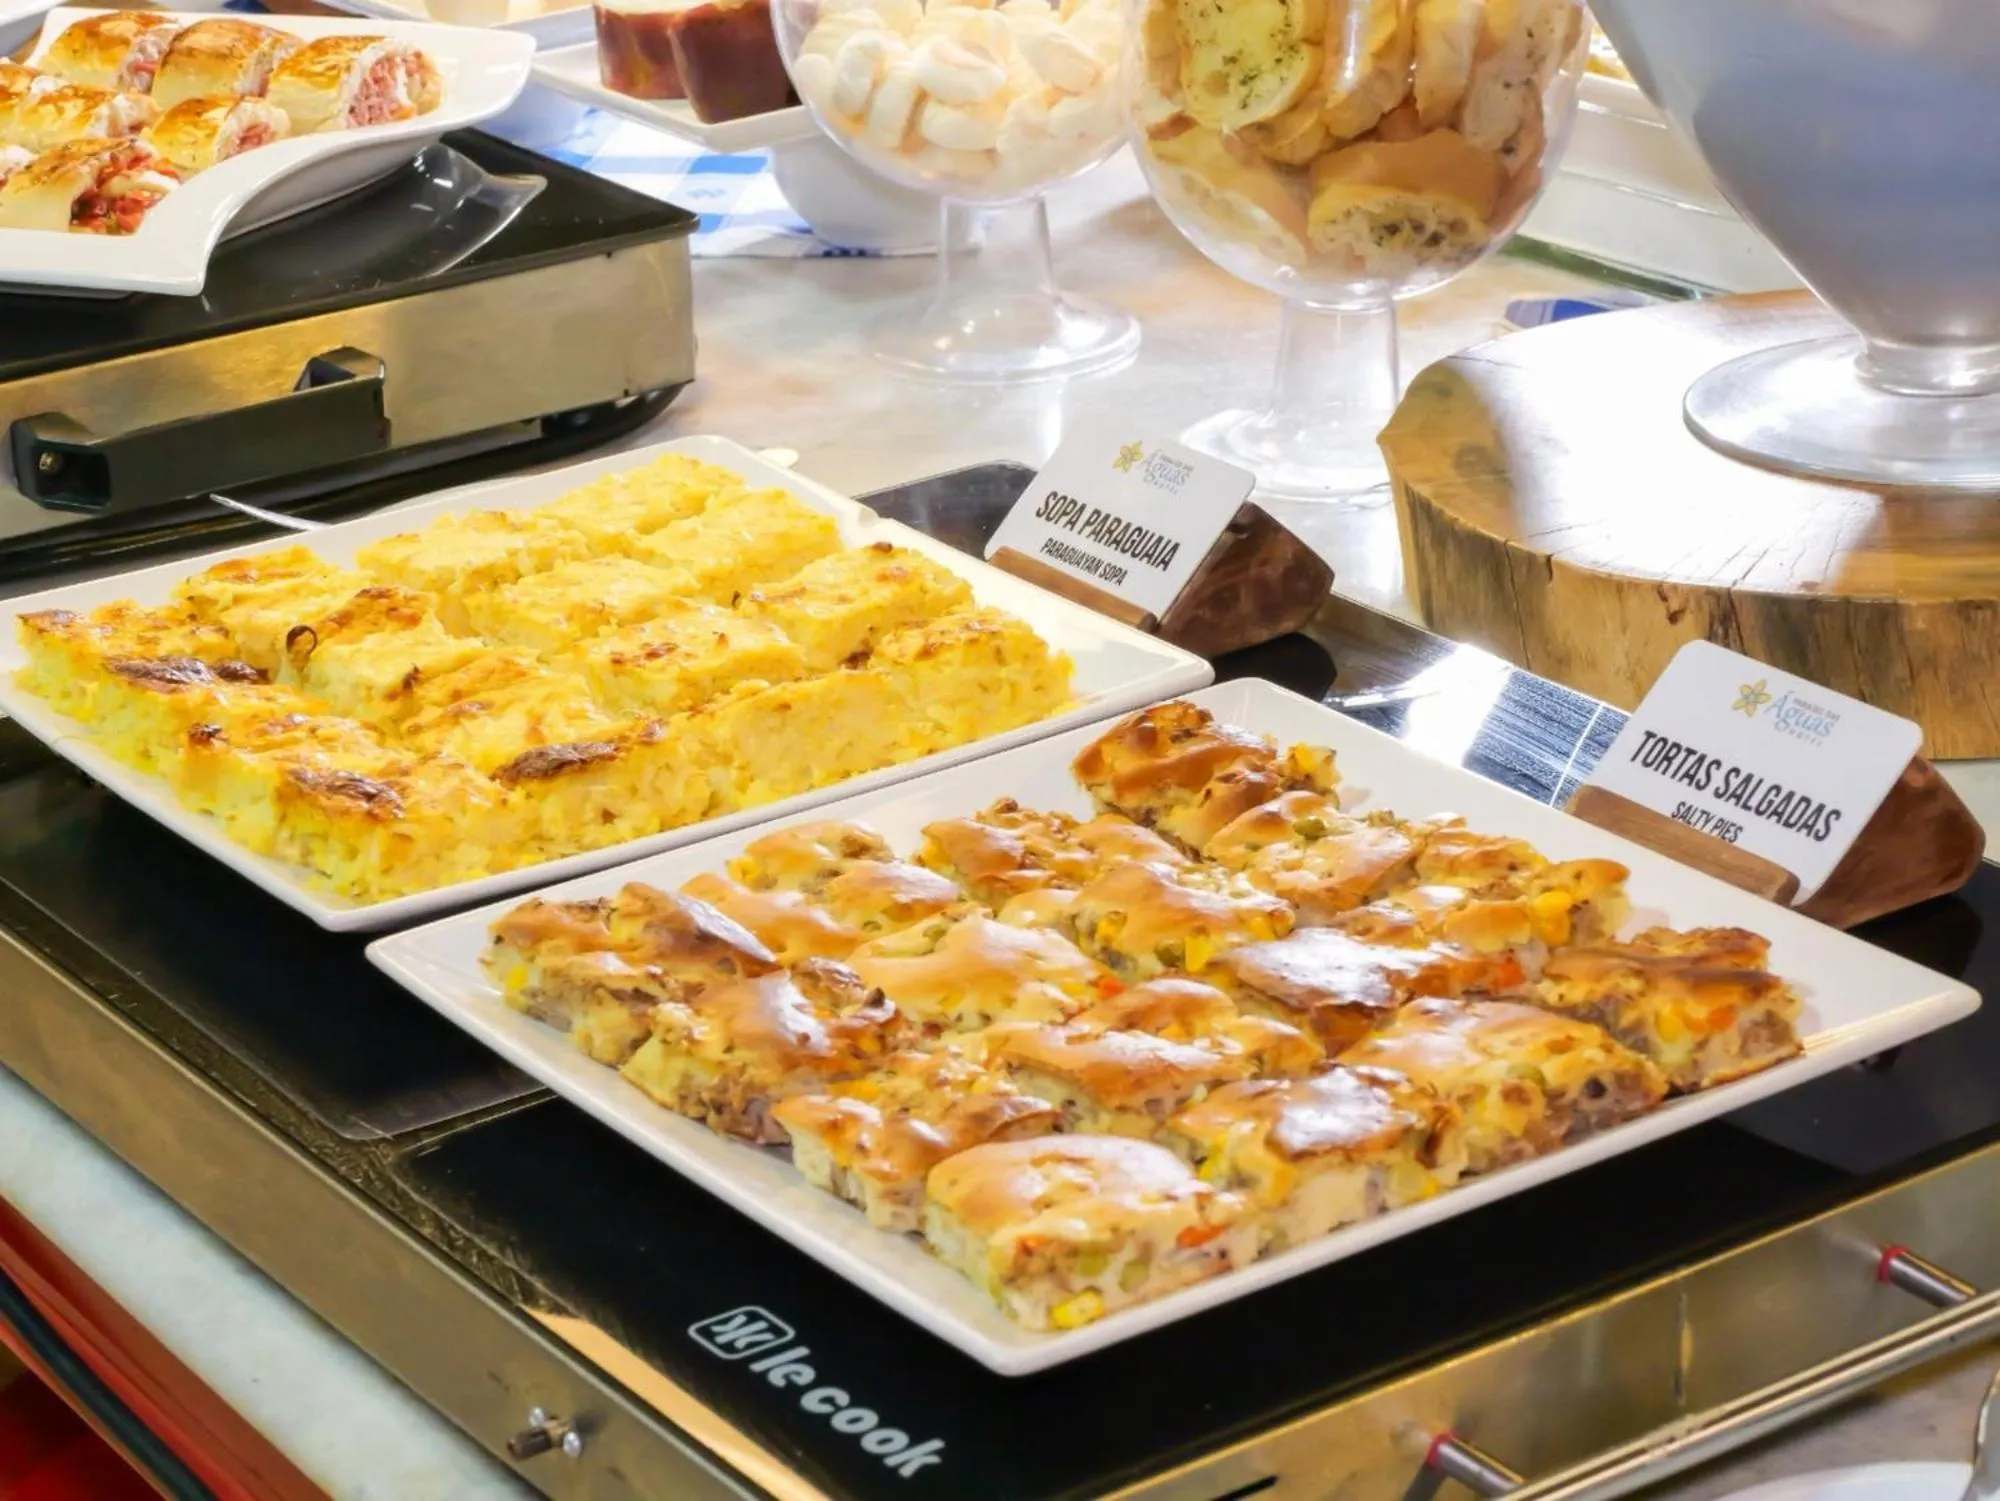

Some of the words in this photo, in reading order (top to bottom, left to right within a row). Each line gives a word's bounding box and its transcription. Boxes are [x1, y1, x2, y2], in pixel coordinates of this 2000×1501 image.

[1036, 491, 1086, 531] SOPA
[1081, 508, 1180, 571] PARAGUAIA
[1041, 538, 1103, 577] PARAGUAYAN
[1100, 562, 1129, 586] SOPA
[1764, 690, 1835, 737] Águas
[1631, 731, 1720, 791] TORTAS
[1714, 767, 1841, 842] SALGADAS
[1672, 802, 1715, 831] SALTY
[1711, 816, 1743, 843] PIES
[800, 1386, 945, 1478] cook
